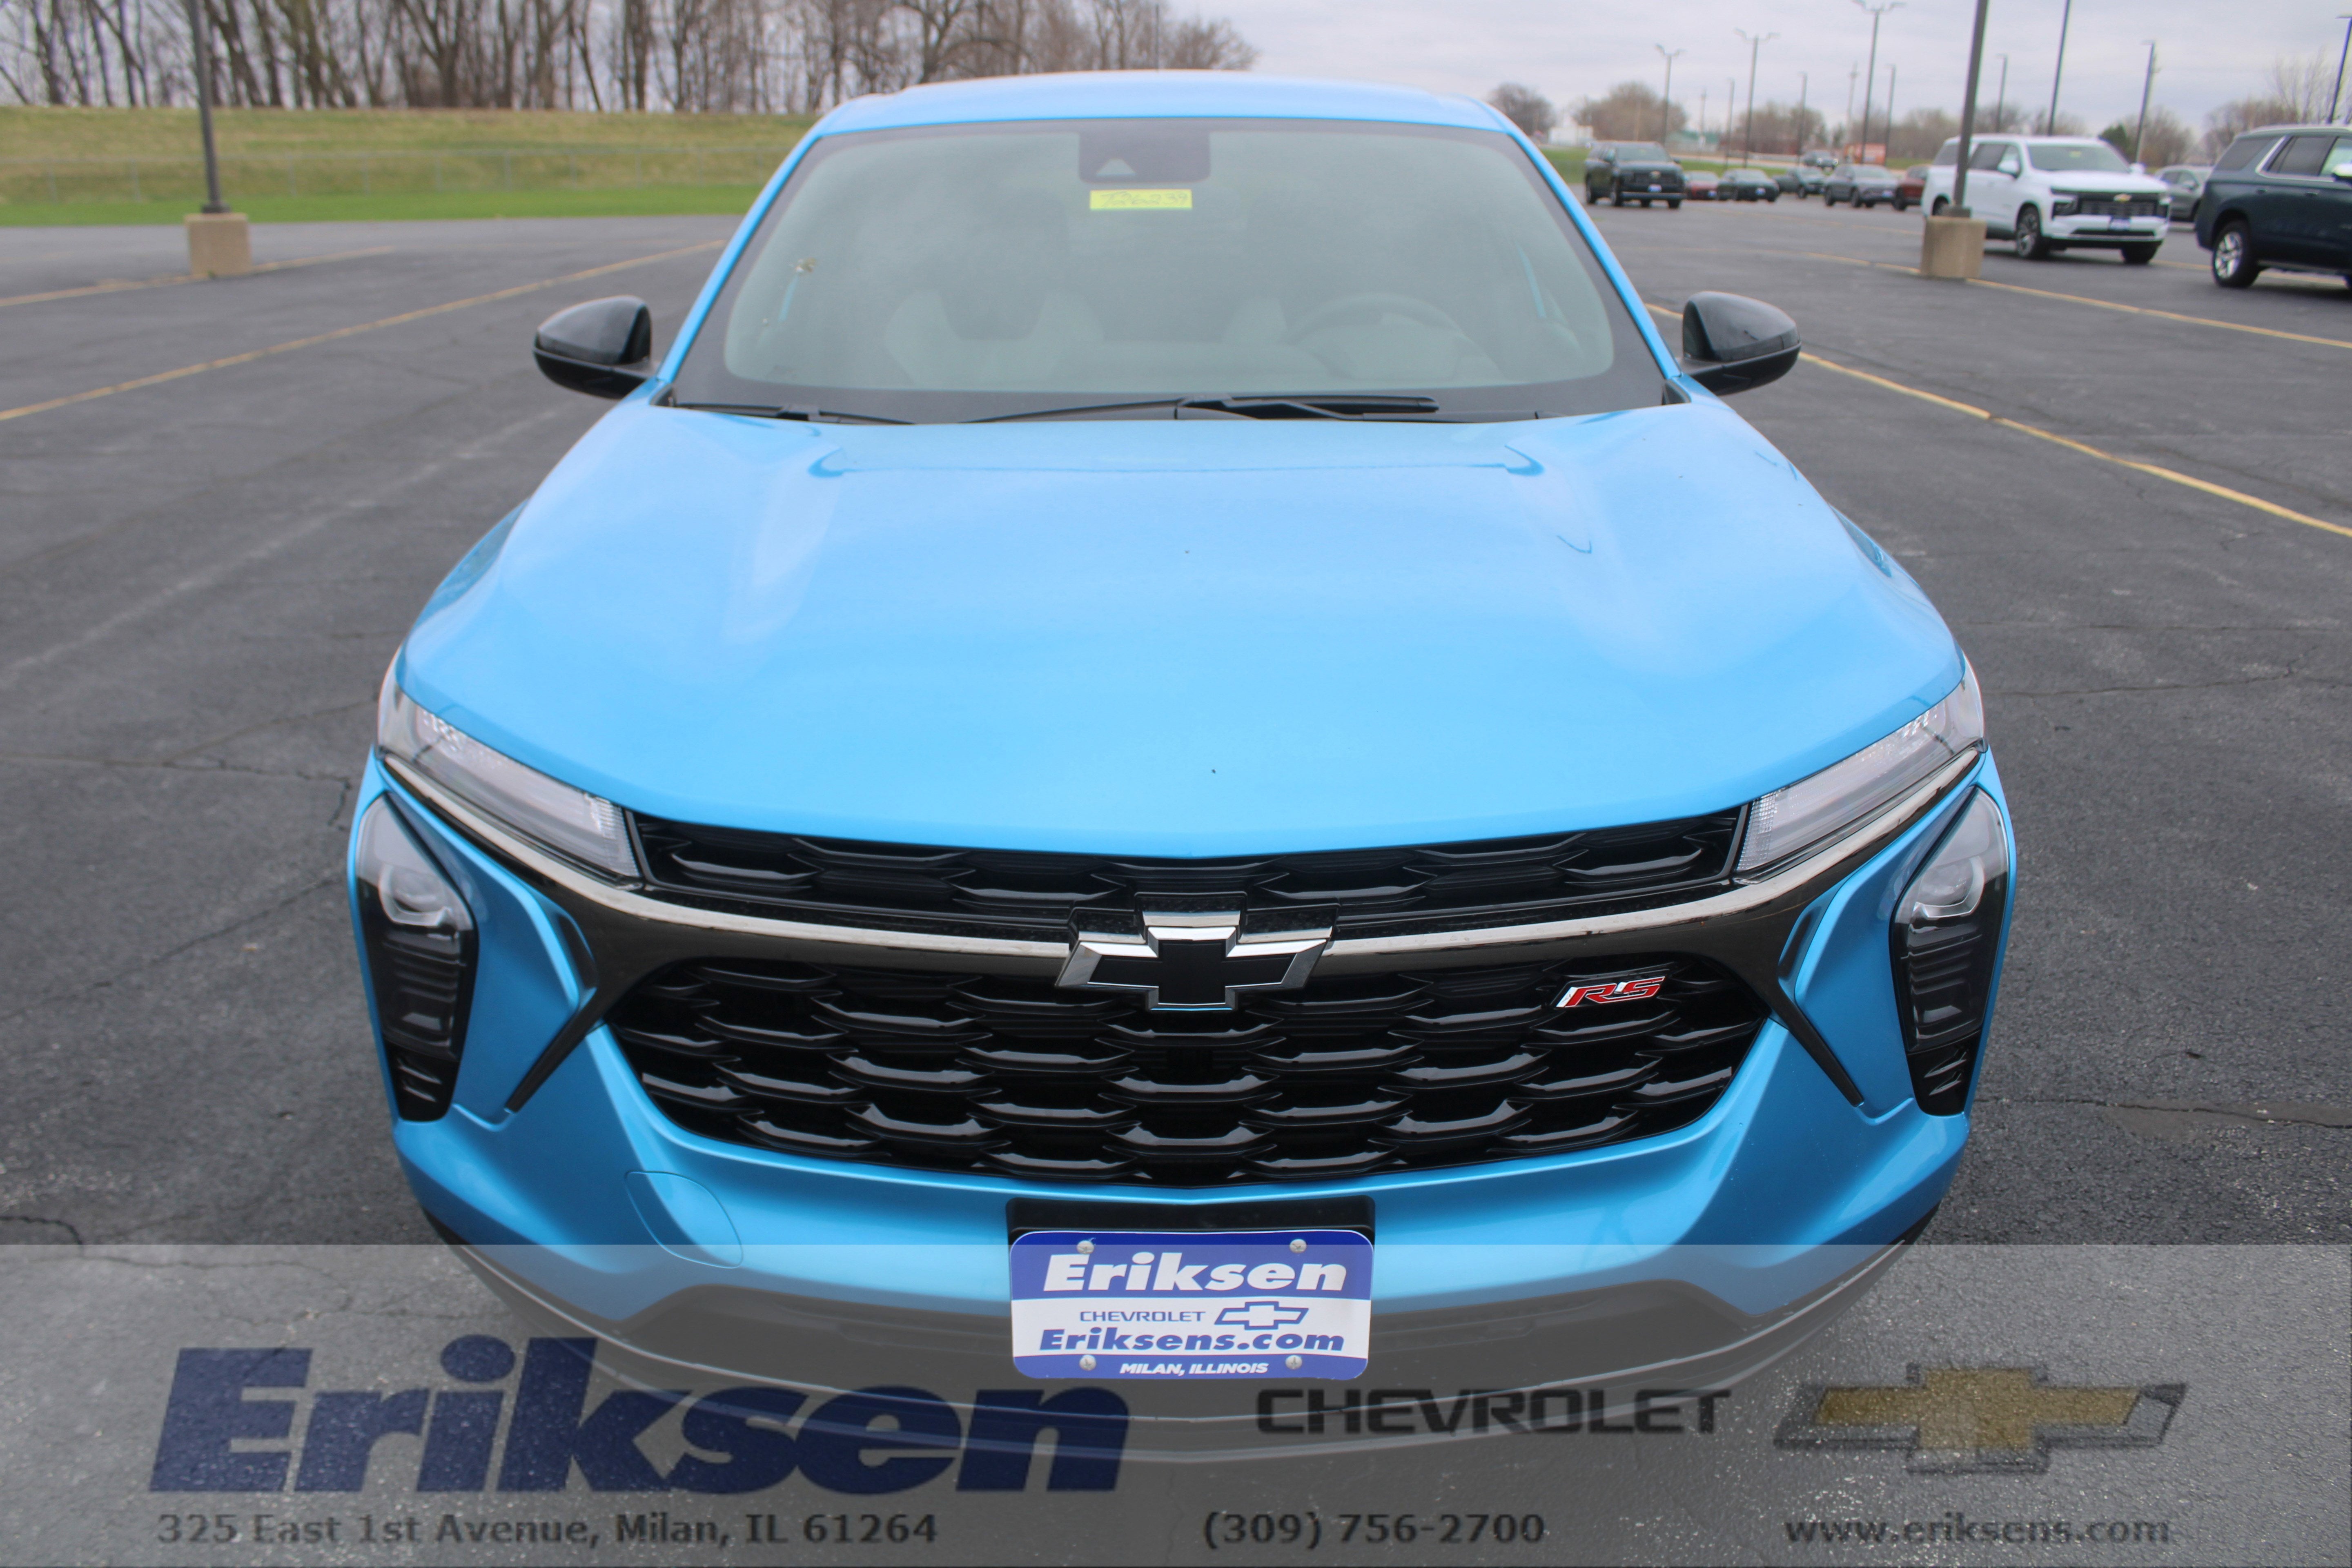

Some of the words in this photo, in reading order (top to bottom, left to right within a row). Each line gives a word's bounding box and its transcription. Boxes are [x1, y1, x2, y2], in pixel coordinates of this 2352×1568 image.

[1556, 976, 1666, 1008] RS
[1043, 1251, 1347, 1292] Eriksen
[1080, 1311, 1206, 1322] CHEVROLET
[1039, 1327, 1345, 1351] Eriksens.com
[1119, 1363, 1185, 1376] MILAN,
[1188, 1362, 1269, 1374] ILLINOIS
